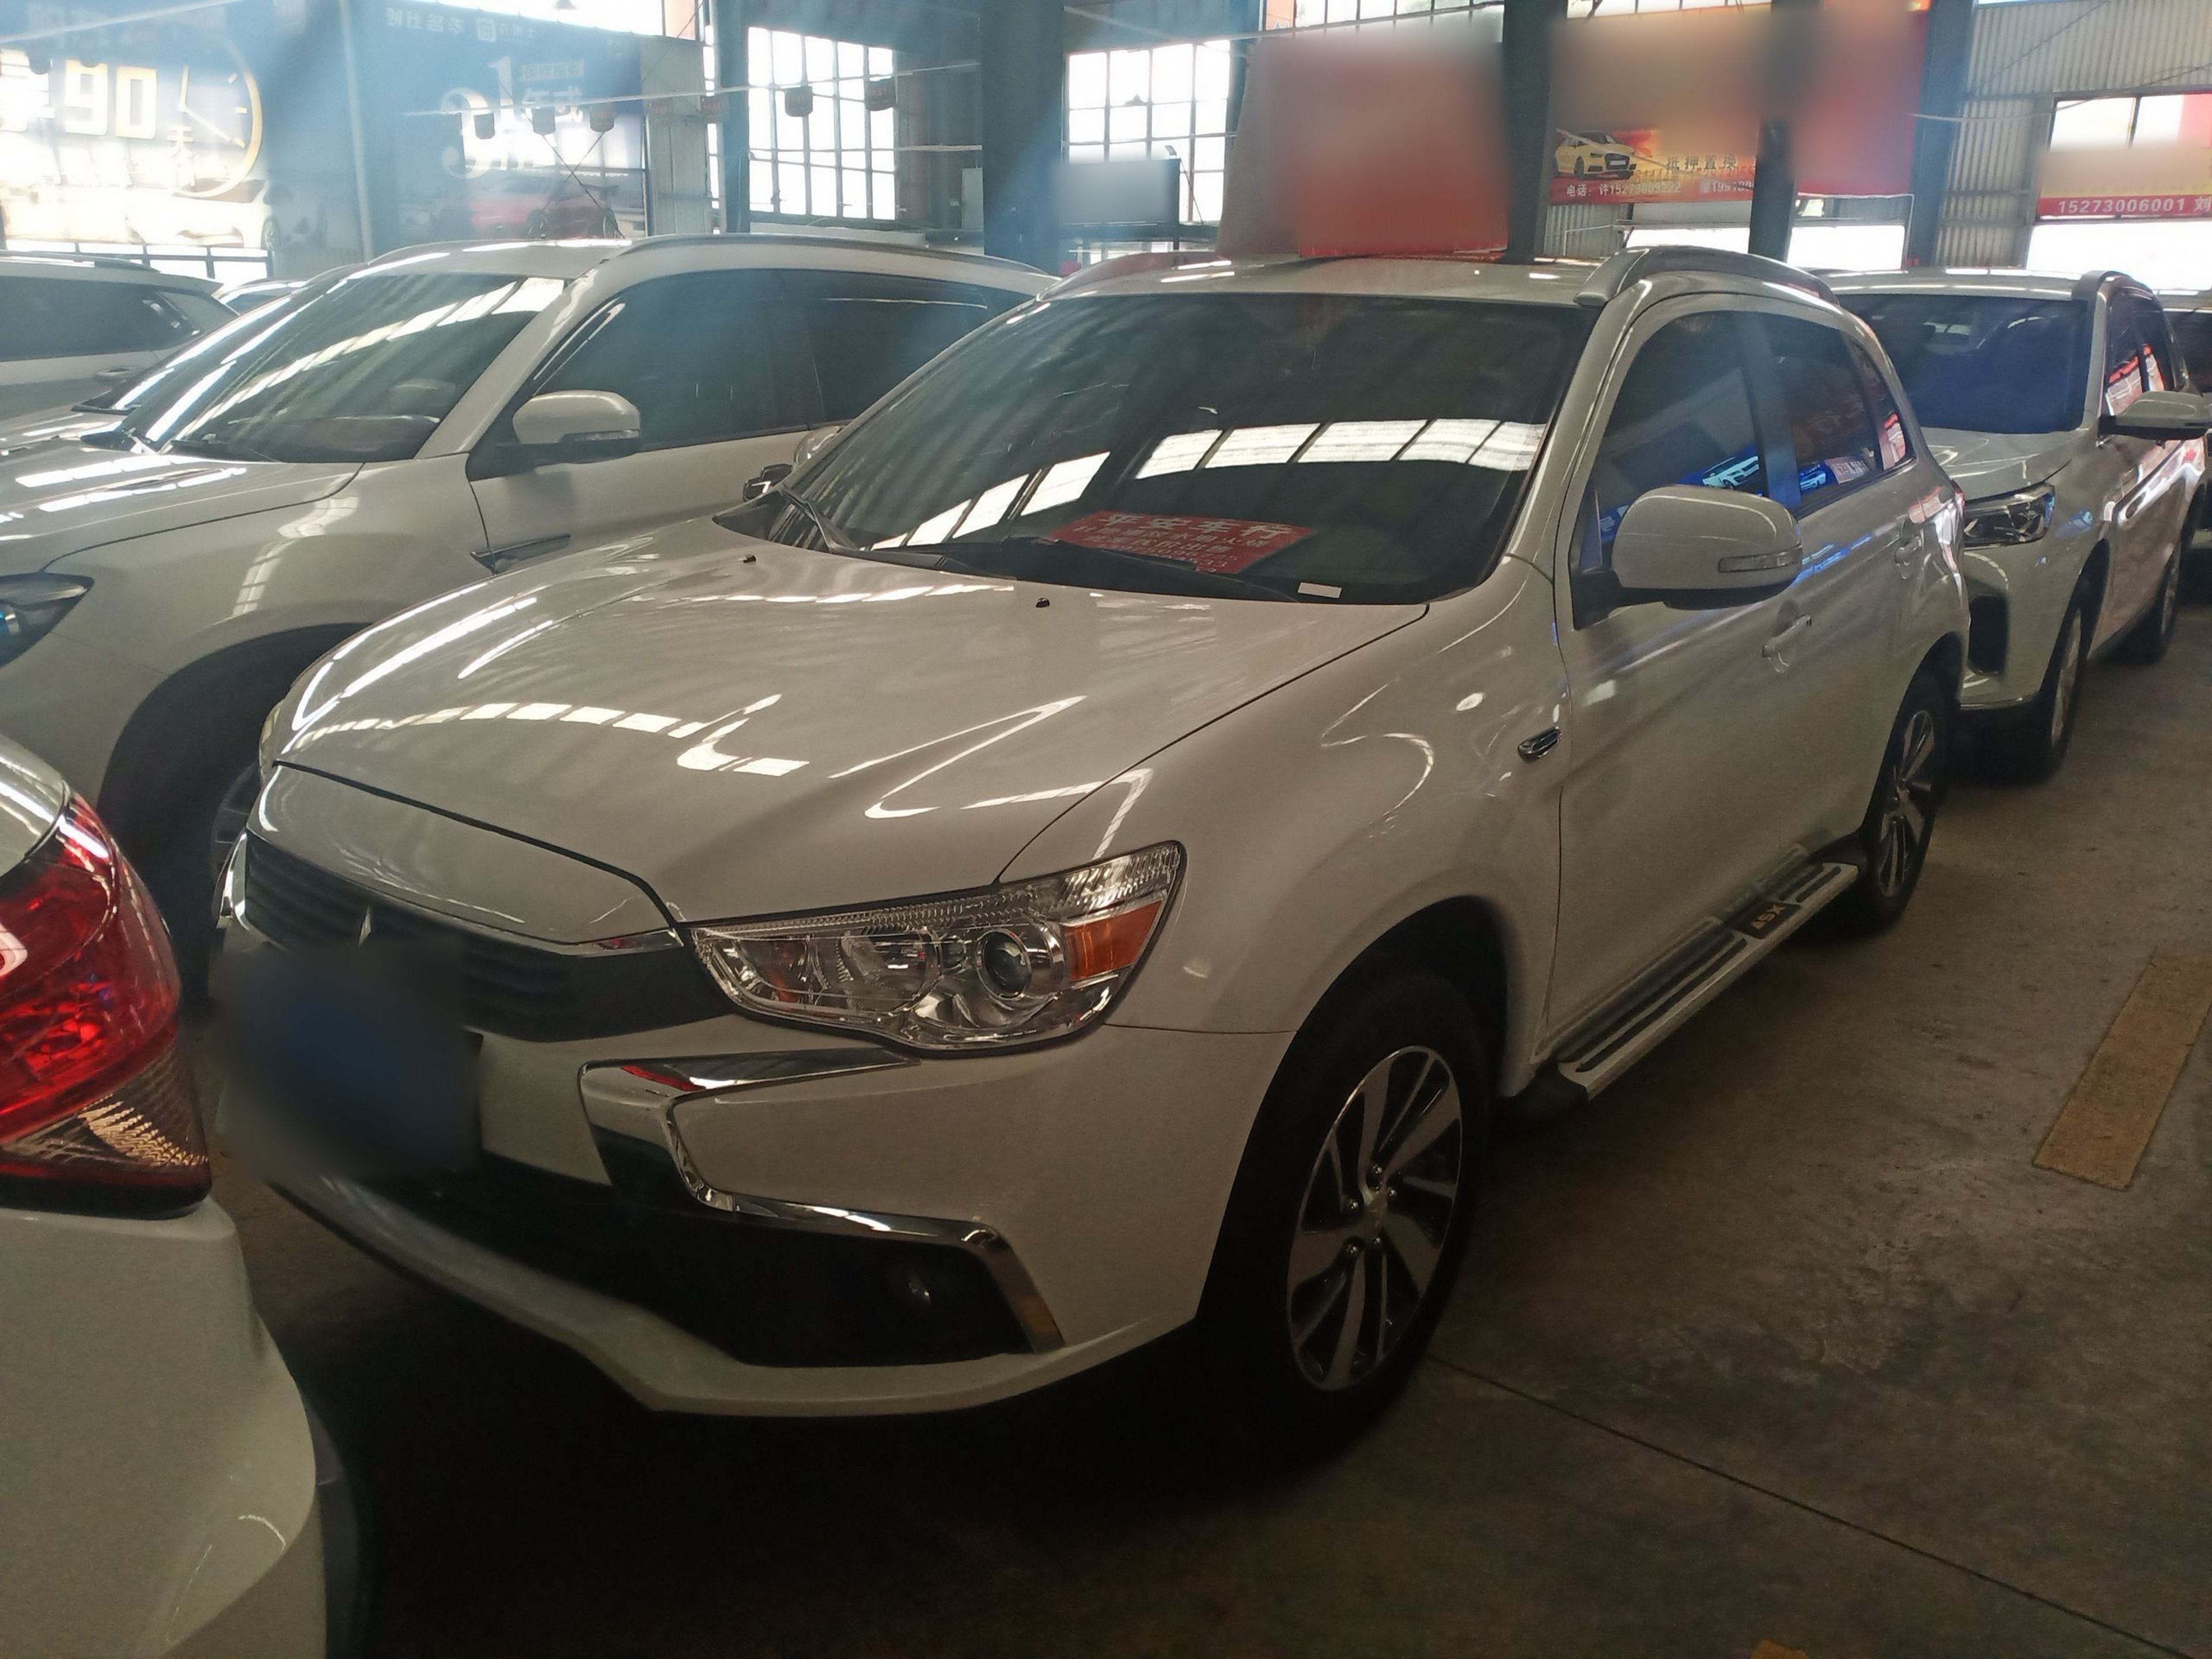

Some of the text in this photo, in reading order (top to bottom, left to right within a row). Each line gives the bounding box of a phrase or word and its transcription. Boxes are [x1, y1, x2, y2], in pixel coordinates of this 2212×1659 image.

[65, 59, 157, 139] 90
[1665, 154, 1737, 171] 抵押置换
[2058, 198, 2185, 214] 15273006001
[1097, 513, 1292, 539] 平安车行
